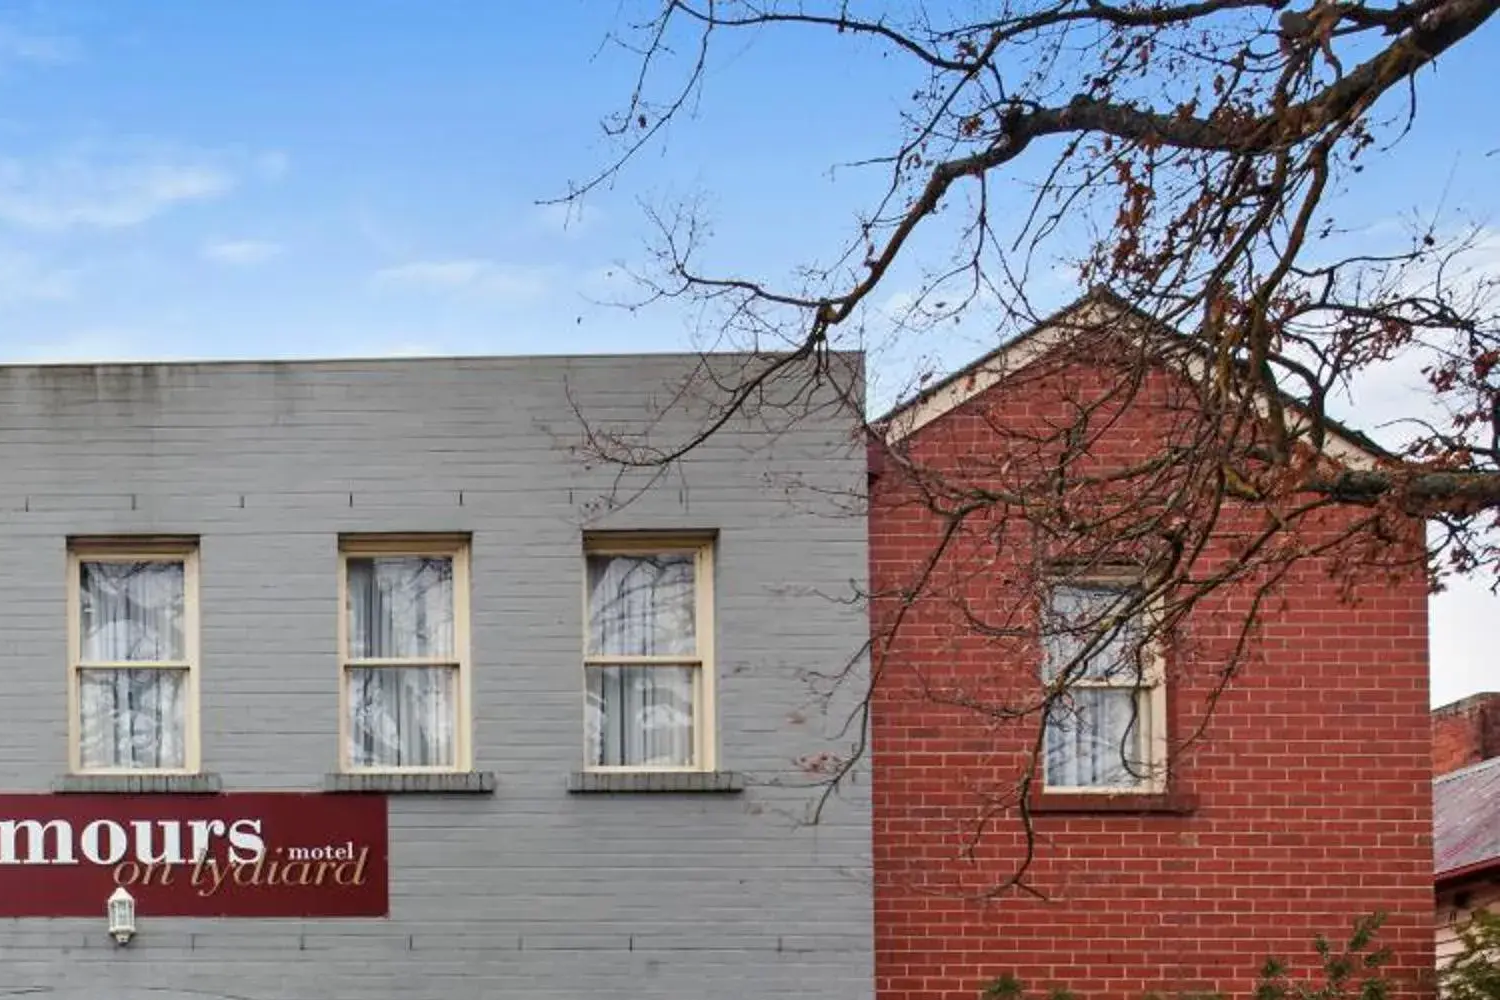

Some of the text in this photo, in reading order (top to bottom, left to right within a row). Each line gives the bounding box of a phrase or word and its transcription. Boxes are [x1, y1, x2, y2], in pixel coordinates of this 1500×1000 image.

[288, 841, 354, 861] motel
[112, 847, 369, 896] on lydiard
